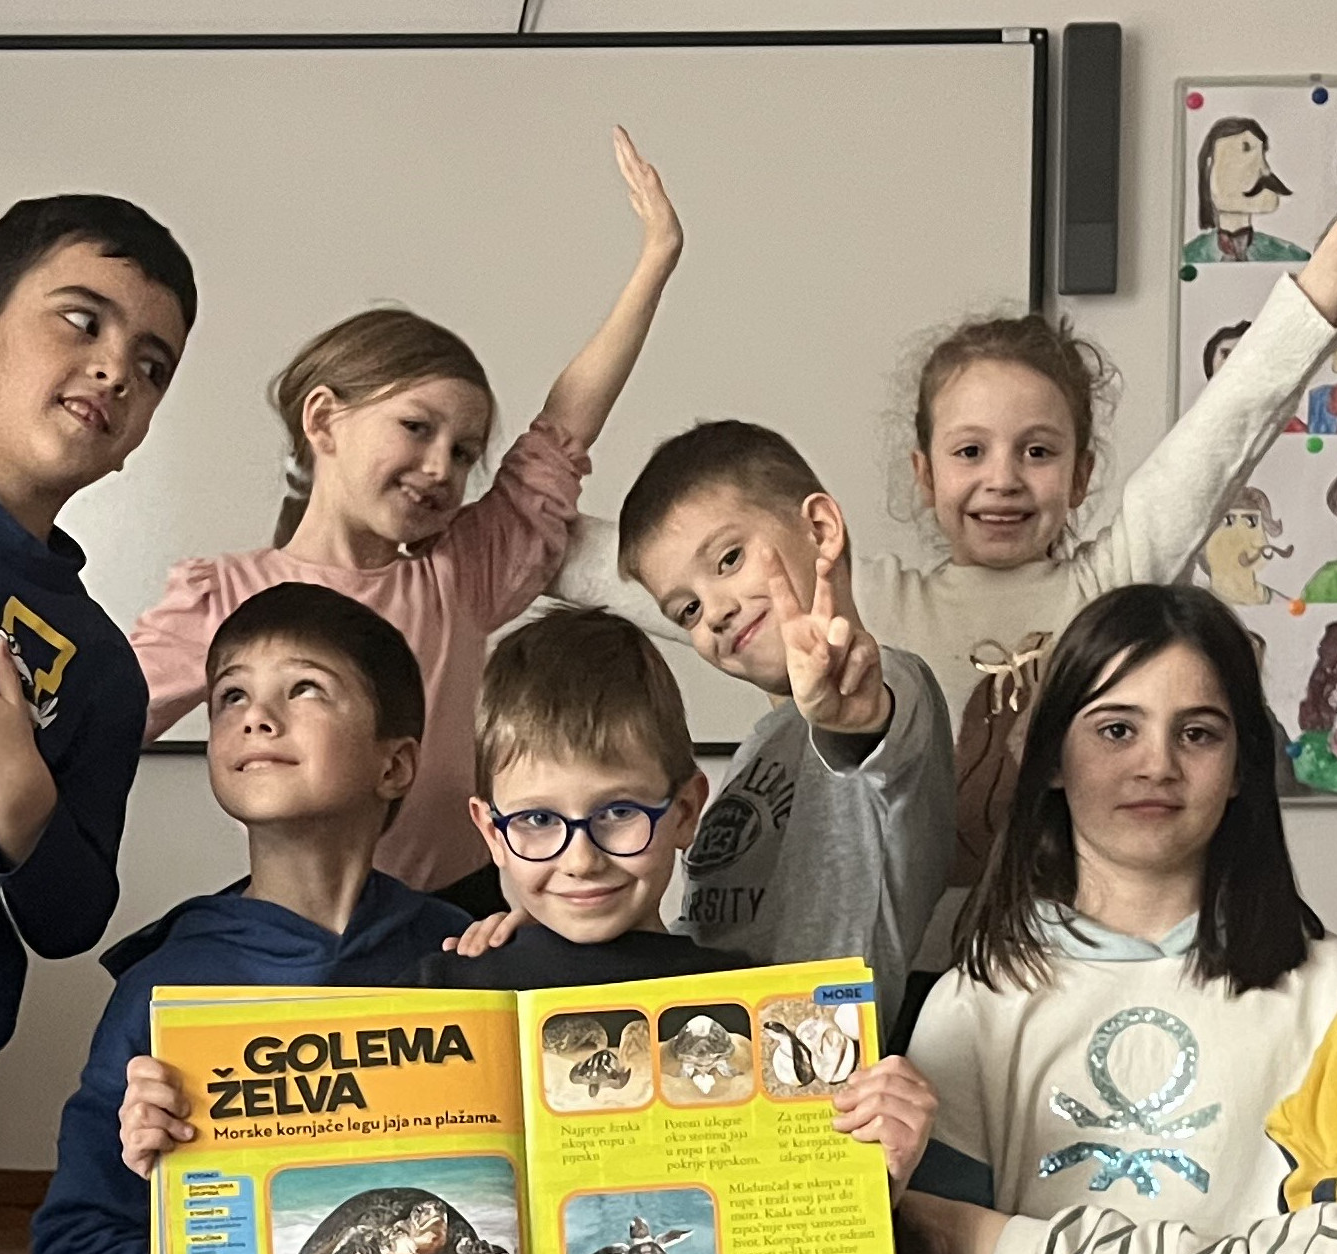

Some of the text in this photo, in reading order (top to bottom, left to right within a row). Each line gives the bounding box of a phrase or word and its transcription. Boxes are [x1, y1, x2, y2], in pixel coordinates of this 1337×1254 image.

[823, 988, 862, 1000] MORE
[244, 1024, 476, 1074] GOLEMA
[207, 1067, 368, 1119] ŽELVA
[777, 1108, 834, 1123] Za otprilik
[214, 1109, 502, 1140] Morske kornjače legu jaja na plažama.
[665, 1119, 701, 1129] Potom
[777, 1125, 792, 1136] 60
[599, 1138, 625, 1148] rupu
[665, 1130, 748, 1143] oko stotinu jaja
[677, 1147, 703, 1158] rupu
[706, 1146, 717, 1154] te
[721, 1142, 731, 1153] ih
[667, 1158, 706, 1173] pokrije
[793, 1182, 803, 1190] se
[730, 1198, 754, 1209] rupe
[817, 1192, 836, 1204] put
[839, 1189, 854, 1200] do
[765, 1207, 792, 1218] Kada
